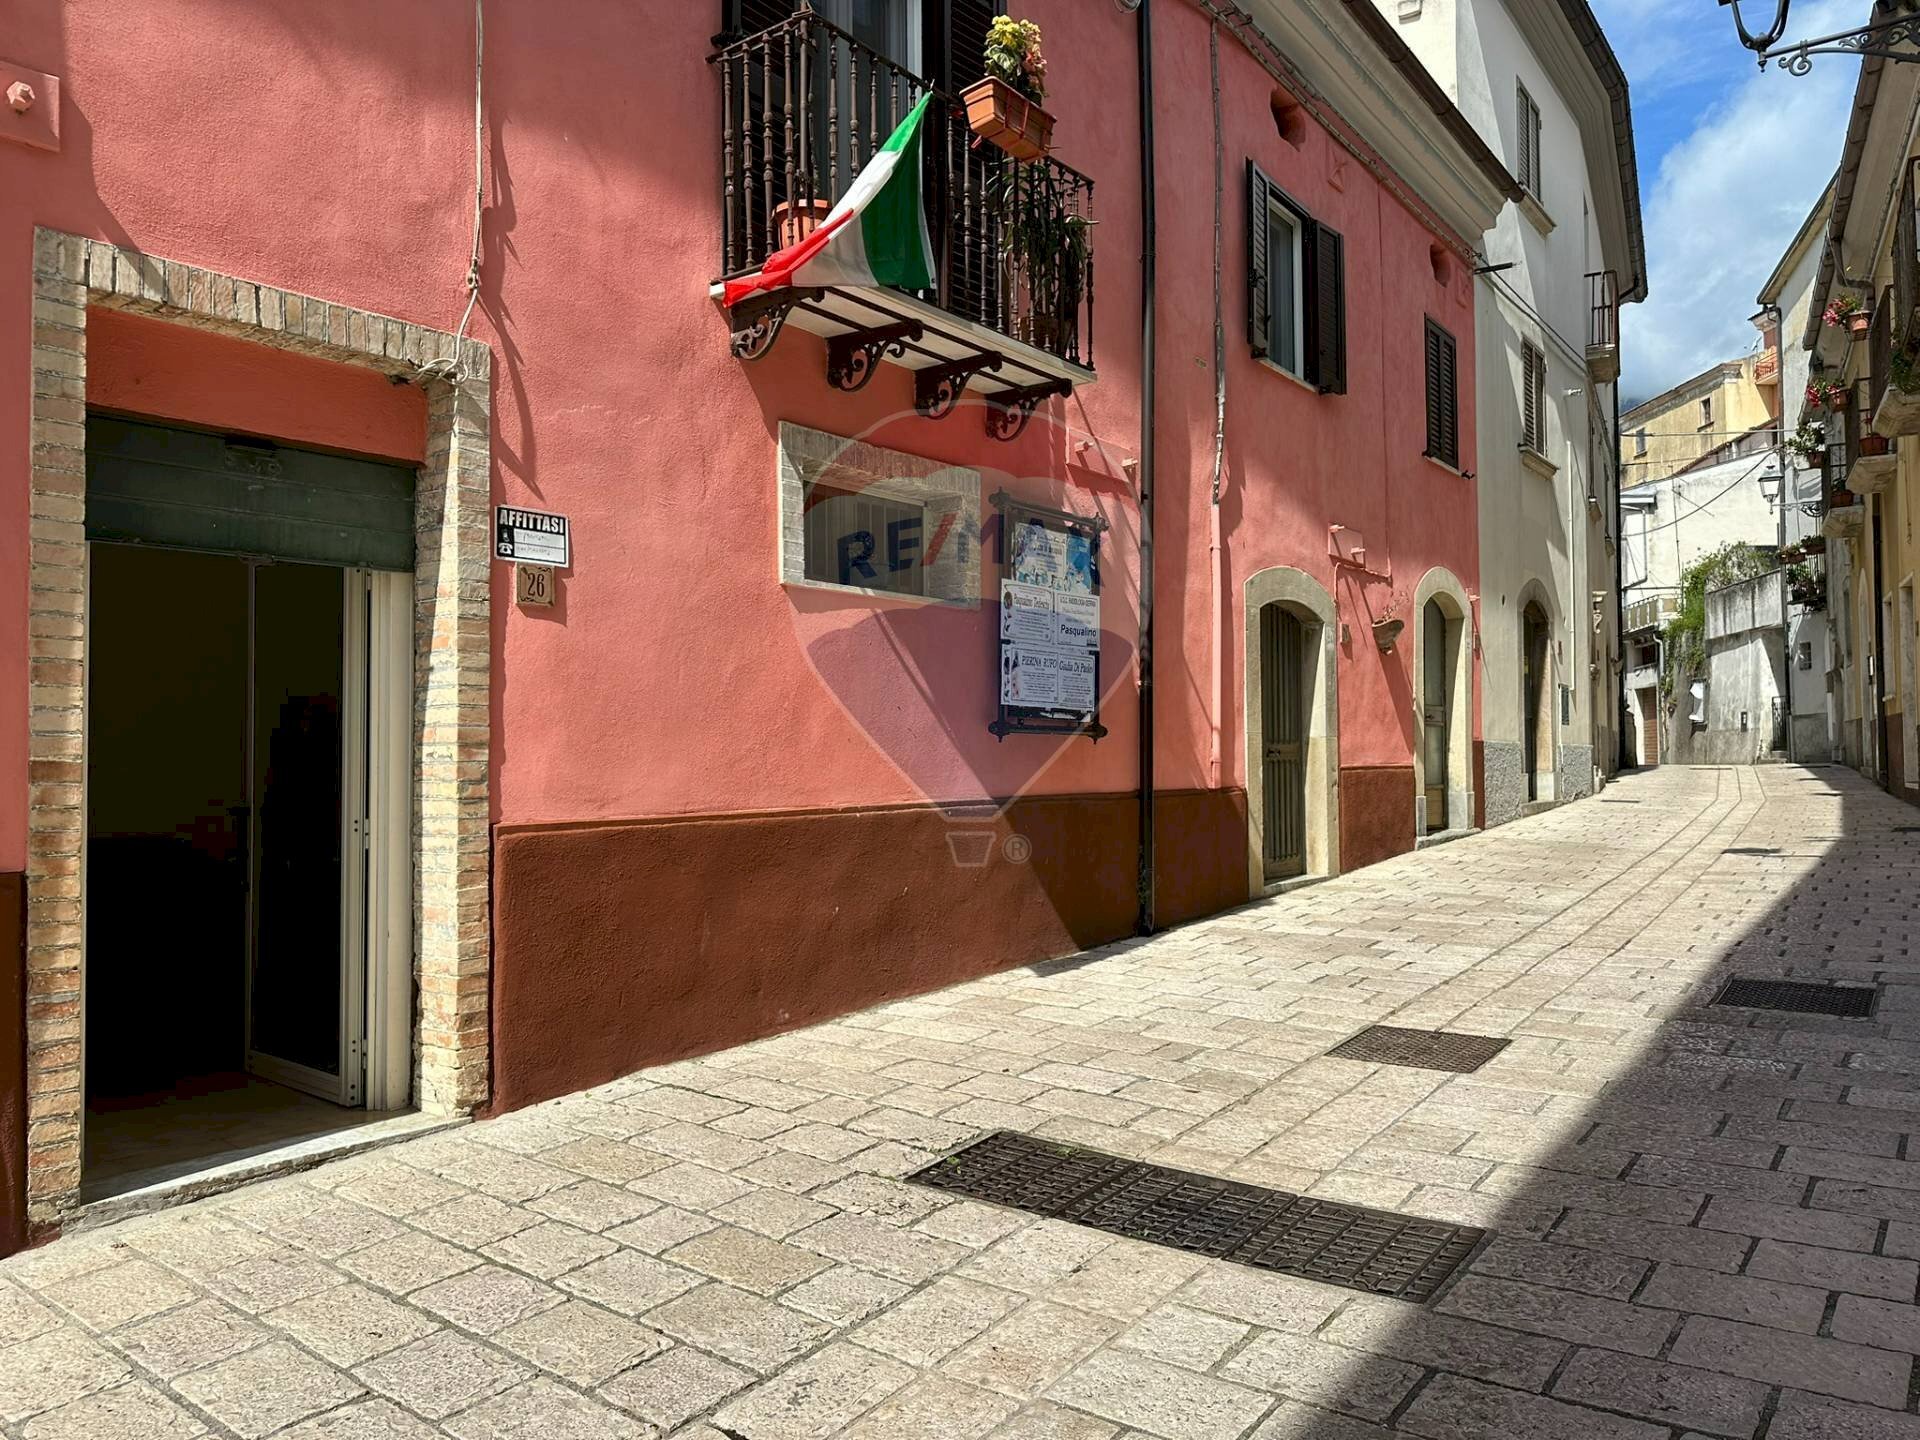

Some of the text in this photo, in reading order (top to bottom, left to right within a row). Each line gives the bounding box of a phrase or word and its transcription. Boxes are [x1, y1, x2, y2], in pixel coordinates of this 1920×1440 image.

[500, 509, 564, 534] AFFITTASI
[527, 572, 545, 597] 26
[1060, 624, 1097, 637] Pasqualino
